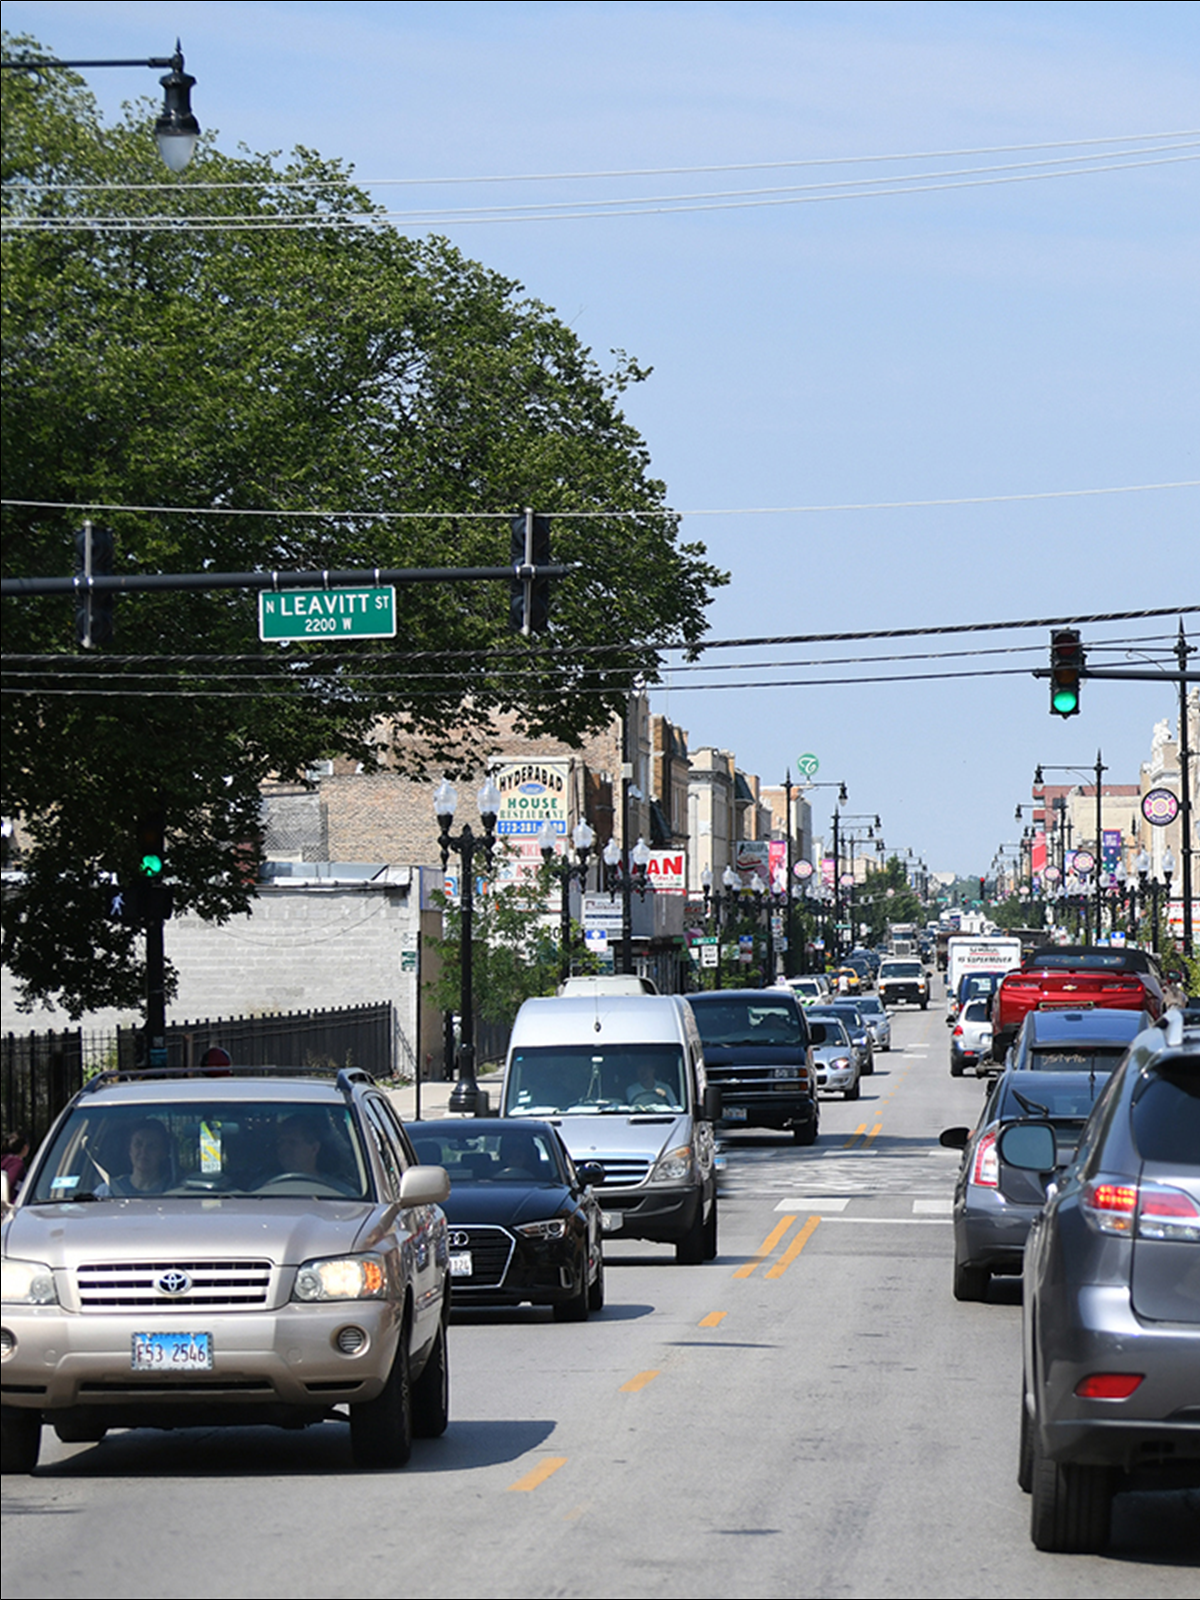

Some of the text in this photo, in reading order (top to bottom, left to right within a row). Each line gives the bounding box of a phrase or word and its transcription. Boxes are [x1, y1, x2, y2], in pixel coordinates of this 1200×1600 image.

[266, 594, 389, 616] N LEAVITT ST
[305, 617, 352, 632] 2200 W
[499, 765, 563, 793] HYDERABAD
[508, 798, 558, 809] HOUSE
[172, 1342, 206, 1362] 2546
